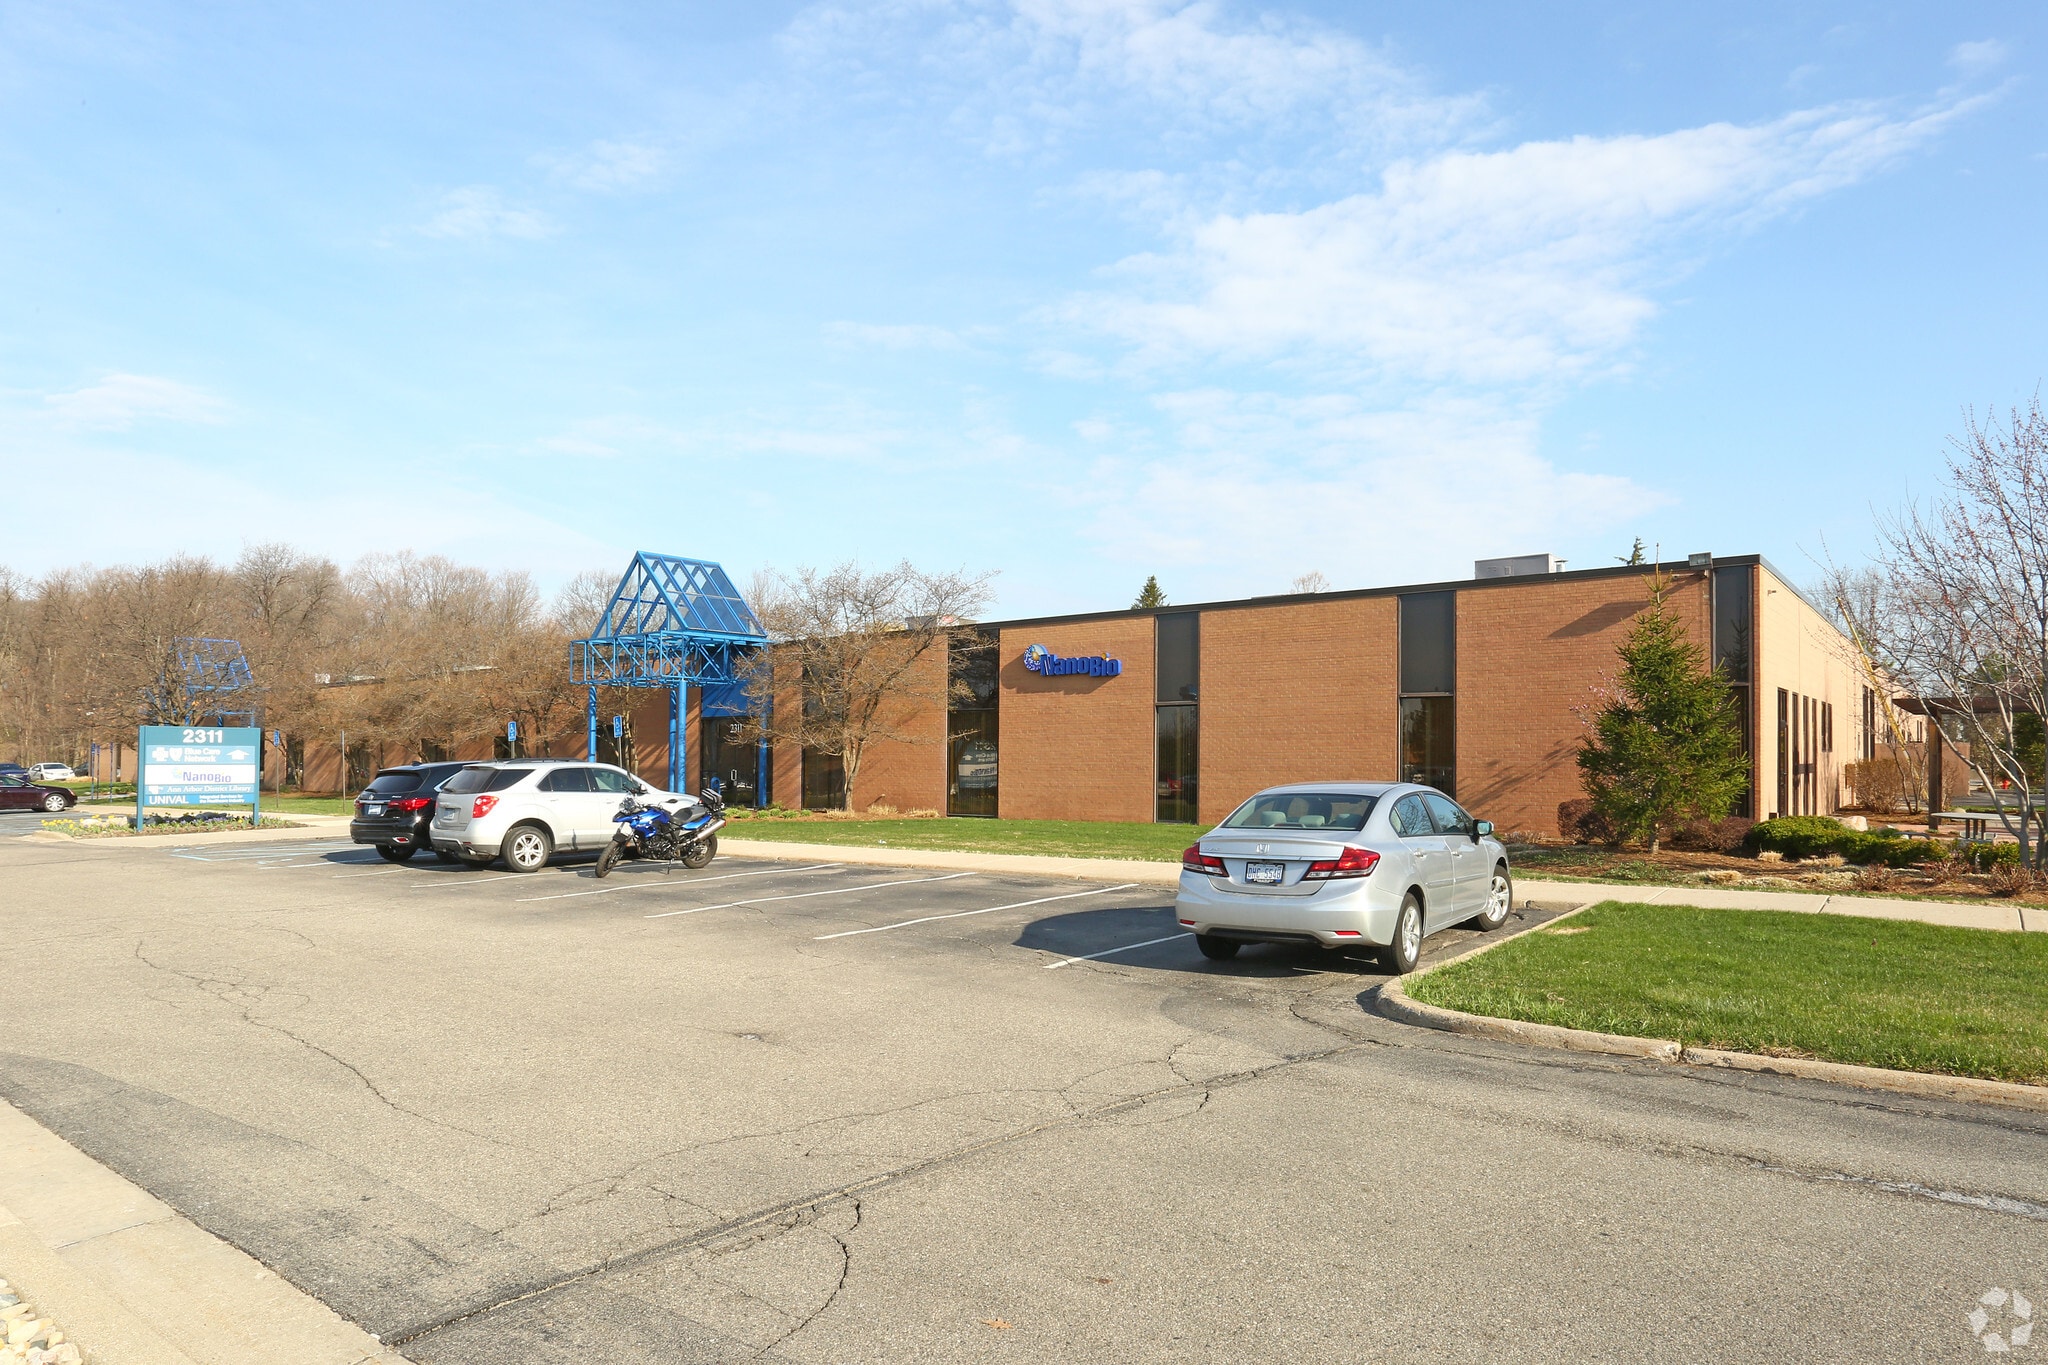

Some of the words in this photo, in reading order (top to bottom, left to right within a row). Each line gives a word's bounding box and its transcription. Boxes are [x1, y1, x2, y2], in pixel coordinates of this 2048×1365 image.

[1040, 653, 1122, 677] NanoBio
[182, 729, 223, 743] 2311
[184, 747, 202, 755] Blue
[202, 747, 221, 755] Care
[182, 771, 232, 783] NanoBio
[229, 785, 251, 793] Library
[149, 795, 189, 805] UNIVAL
